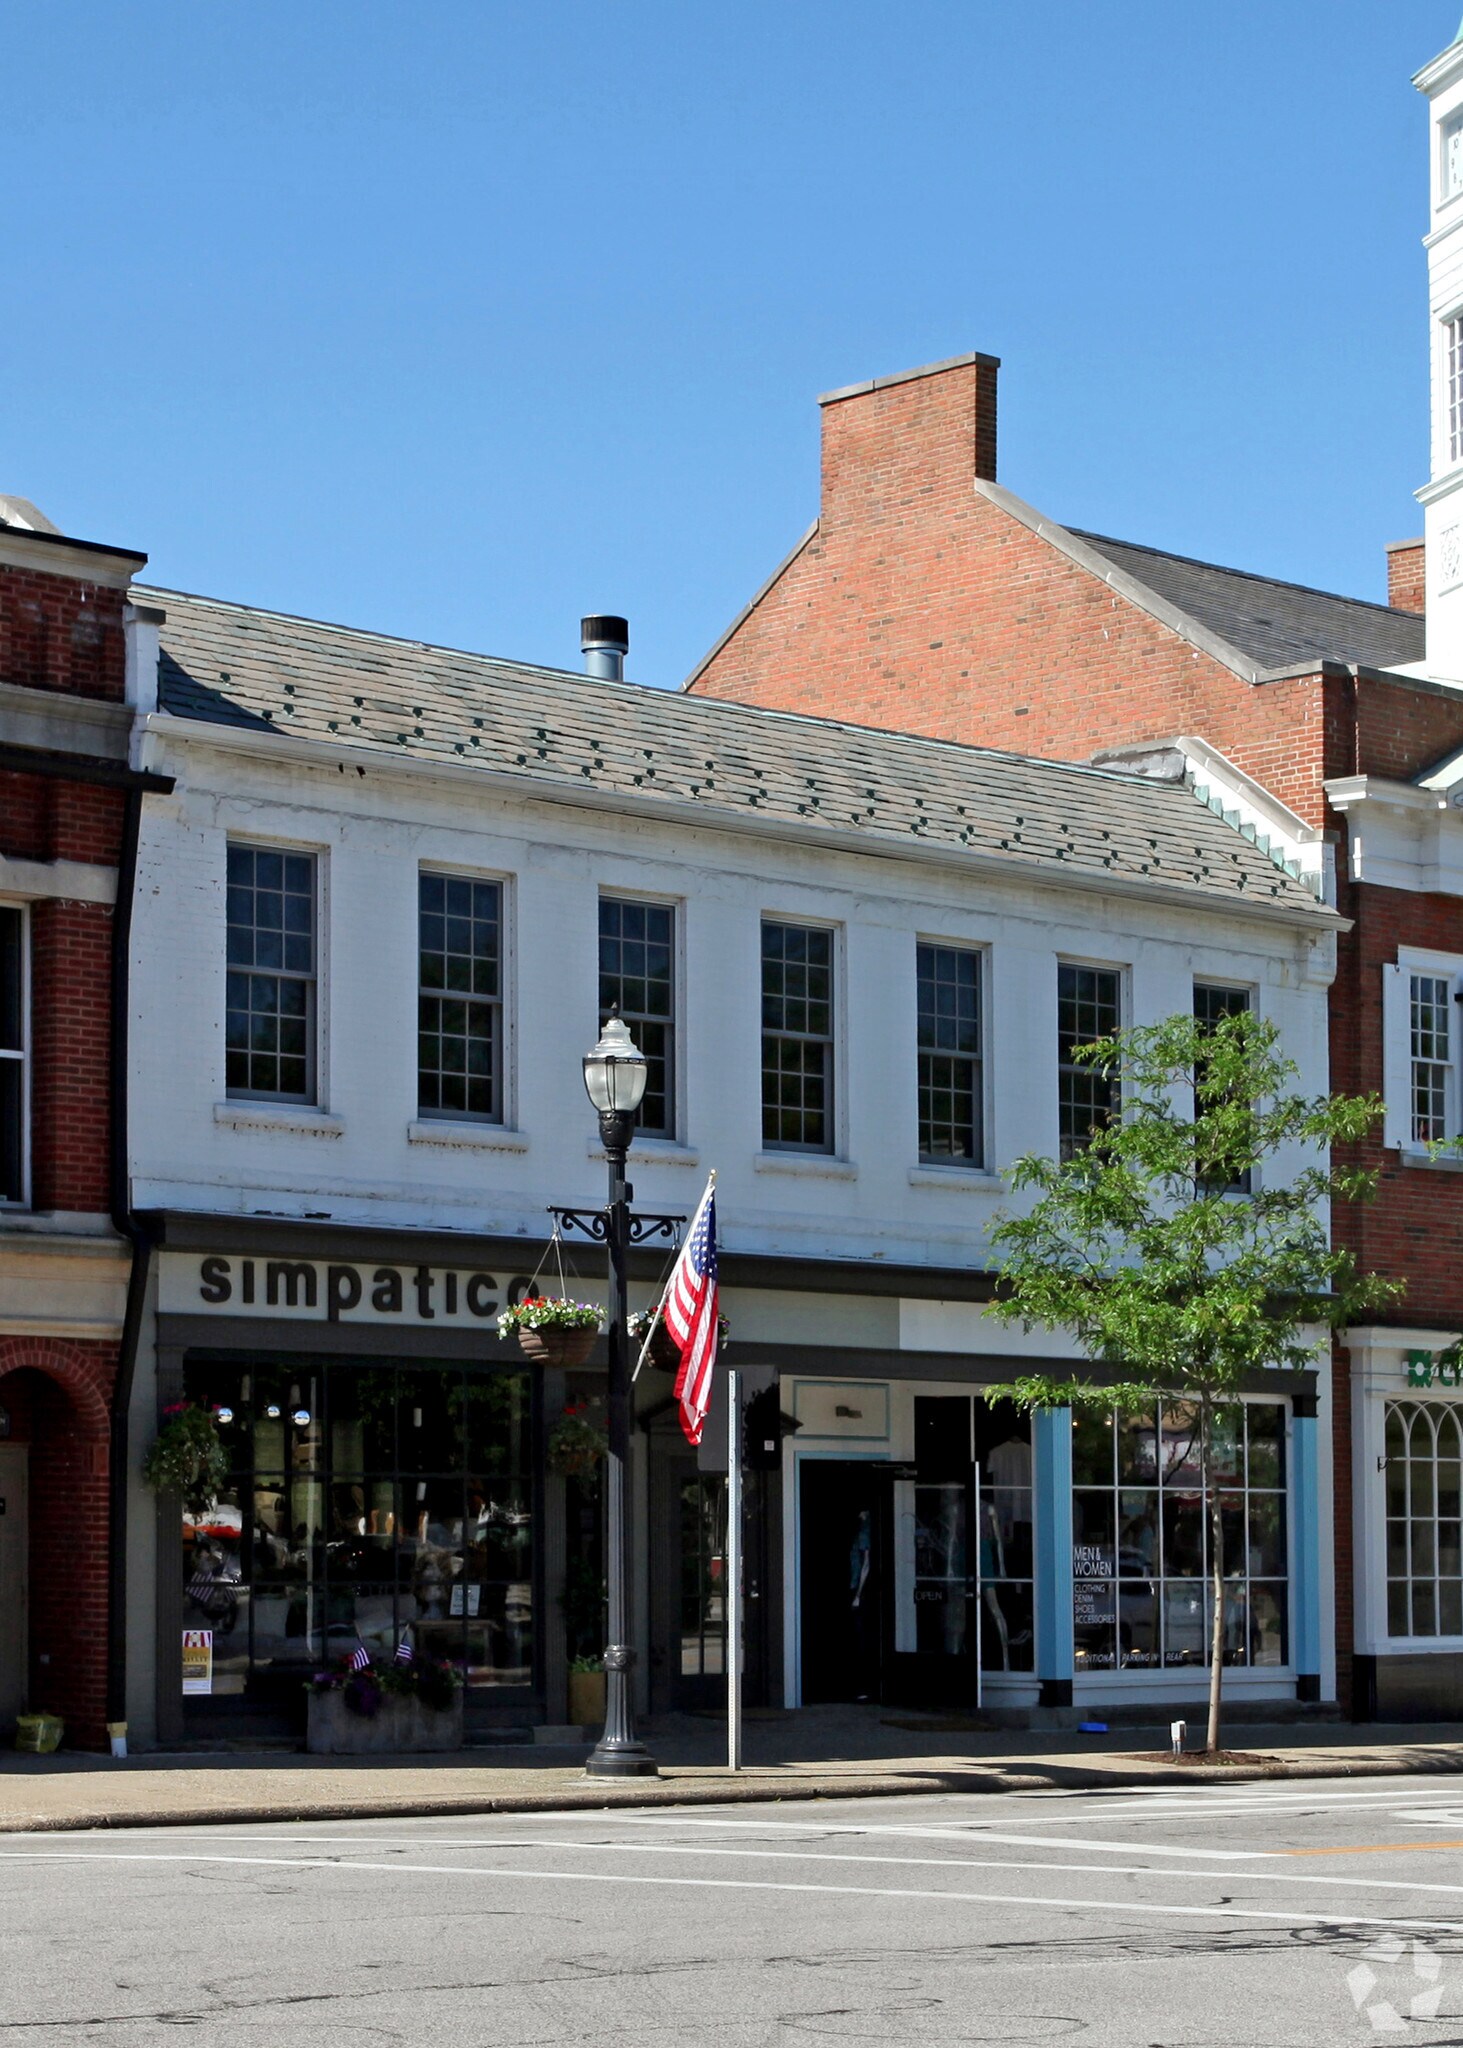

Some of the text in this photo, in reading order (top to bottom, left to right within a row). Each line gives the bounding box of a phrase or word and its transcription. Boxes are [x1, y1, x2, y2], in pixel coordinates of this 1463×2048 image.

[200, 1257, 540, 1322] simpatico
[1074, 1546, 1096, 1560] MEN
[1074, 1561, 1112, 1576] WOMEN
[1074, 1584, 1105, 1593] CLOTHING
[916, 1591, 942, 1600] OPEN
[1074, 1594, 1094, 1603] DENIM
[1074, 1604, 1095, 1614] SHOES
[1075, 1615, 1115, 1623] ACCESSORIES
[1166, 1651, 1183, 1661] REAR
